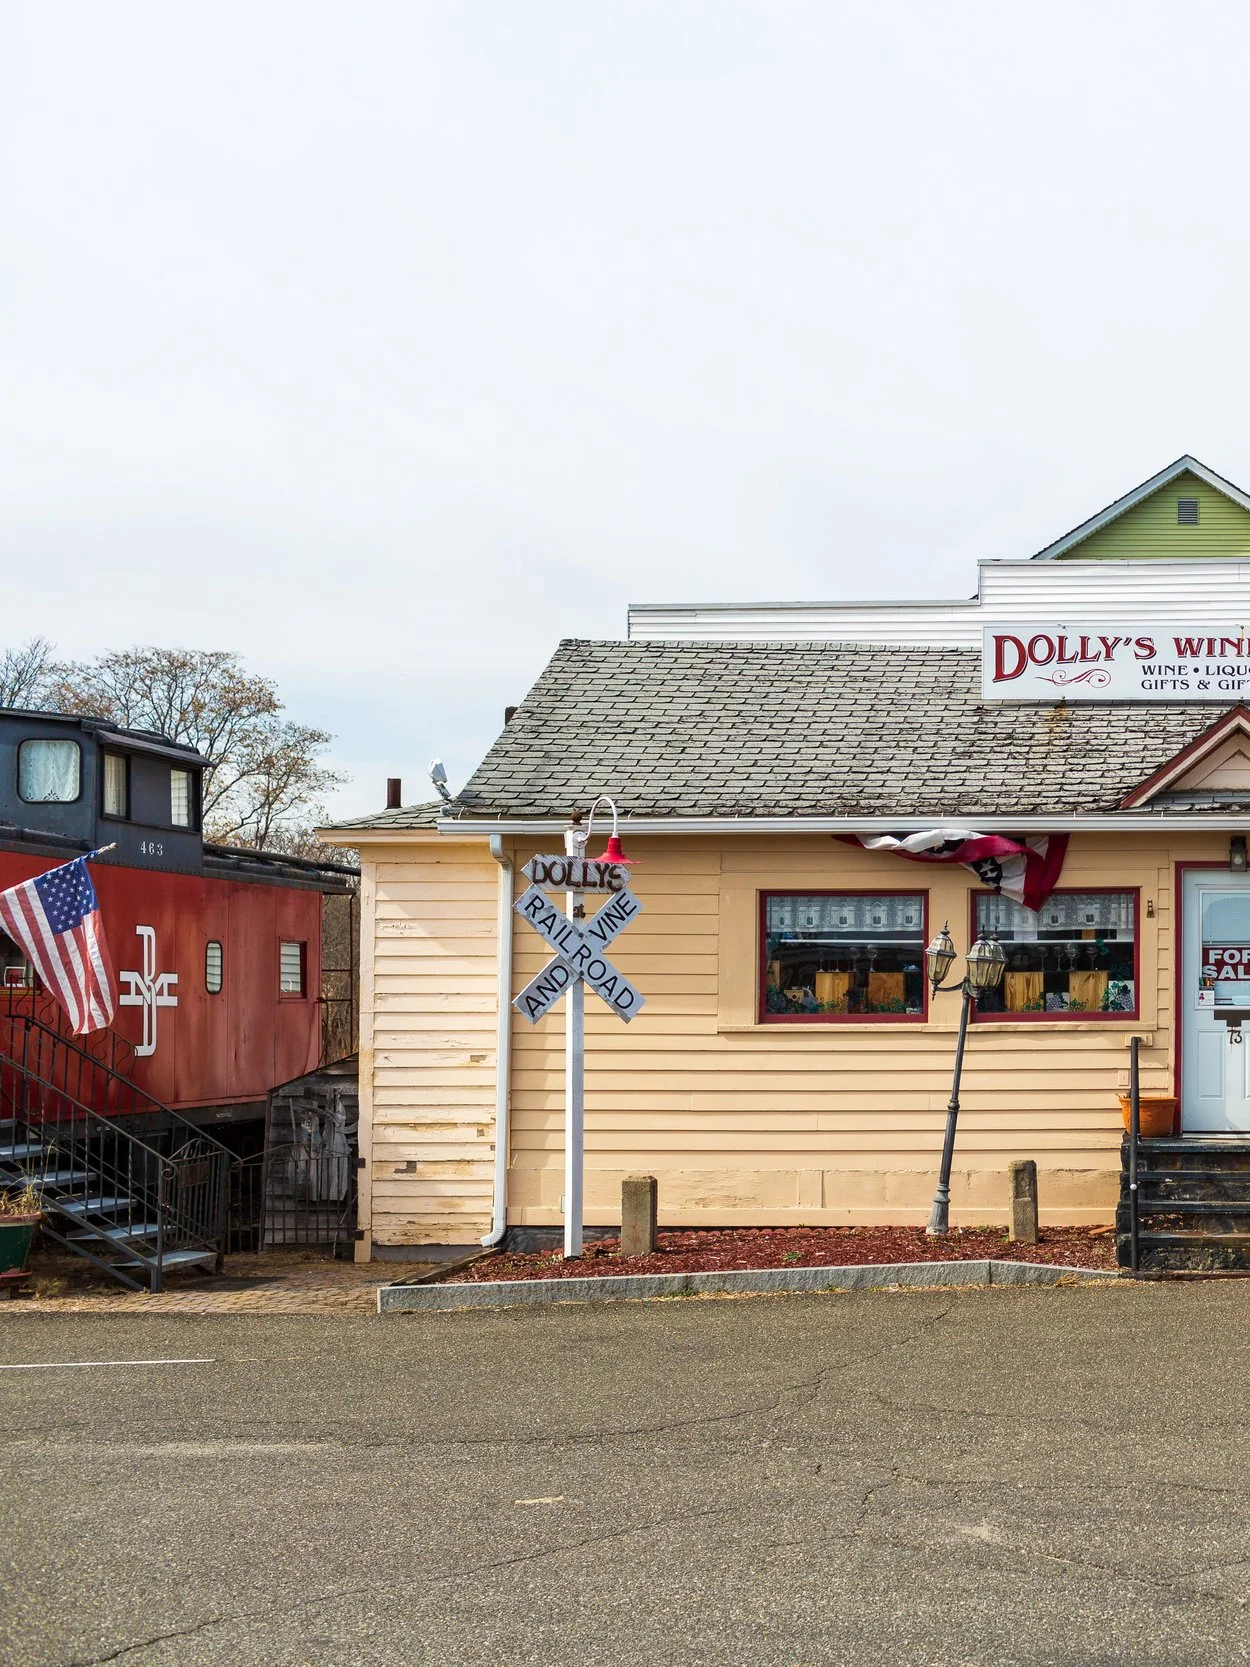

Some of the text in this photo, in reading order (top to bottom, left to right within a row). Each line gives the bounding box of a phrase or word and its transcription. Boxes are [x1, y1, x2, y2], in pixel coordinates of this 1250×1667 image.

[992, 634, 1157, 683] DOLLY'S
[1141, 665, 1188, 676] WINE
[1141, 679, 1190, 690] GIFTS
[1197, 679, 1210, 690] &
[140, 841, 163, 856] 463
[532, 859, 624, 892] DOLLYS
[573, 903, 586, 918] at
[524, 894, 635, 1010] RAILROAD
[525, 892, 637, 1017] AND VINE
[1227, 1030, 1243, 1044] 73
